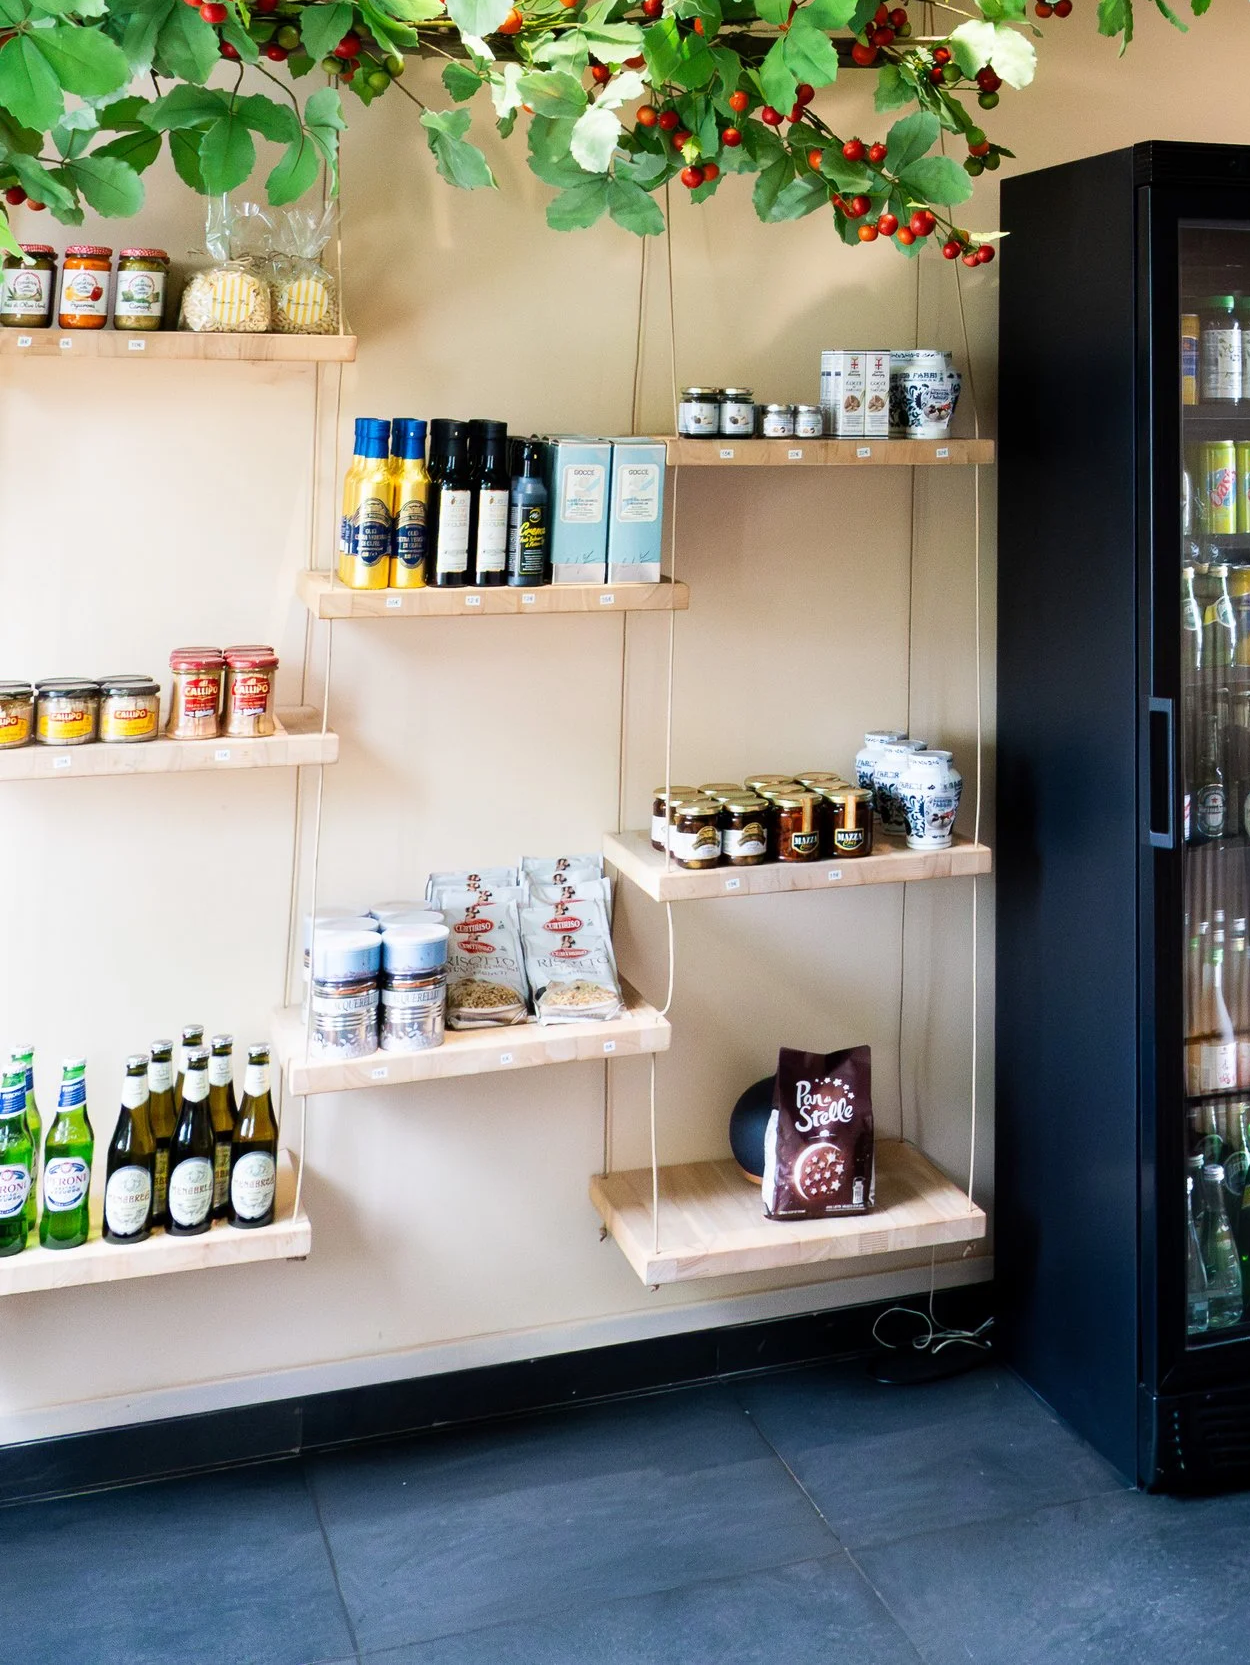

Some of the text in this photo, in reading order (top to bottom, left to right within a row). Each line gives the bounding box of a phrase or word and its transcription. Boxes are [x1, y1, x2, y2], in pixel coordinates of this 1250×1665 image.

[185, 685, 218, 696] CALLIPO
[233, 683, 268, 694] CALLIPO
[51, 711, 82, 720] CALLIPO
[115, 709, 146, 719] CALLIPO
[794, 835, 817, 845] MAZZA
[836, 831, 863, 842] MAZZA
[796, 1080, 827, 1109] Pan
[795, 1097, 854, 1132] Stelle
[46, 1173, 87, 1186] PERONI
